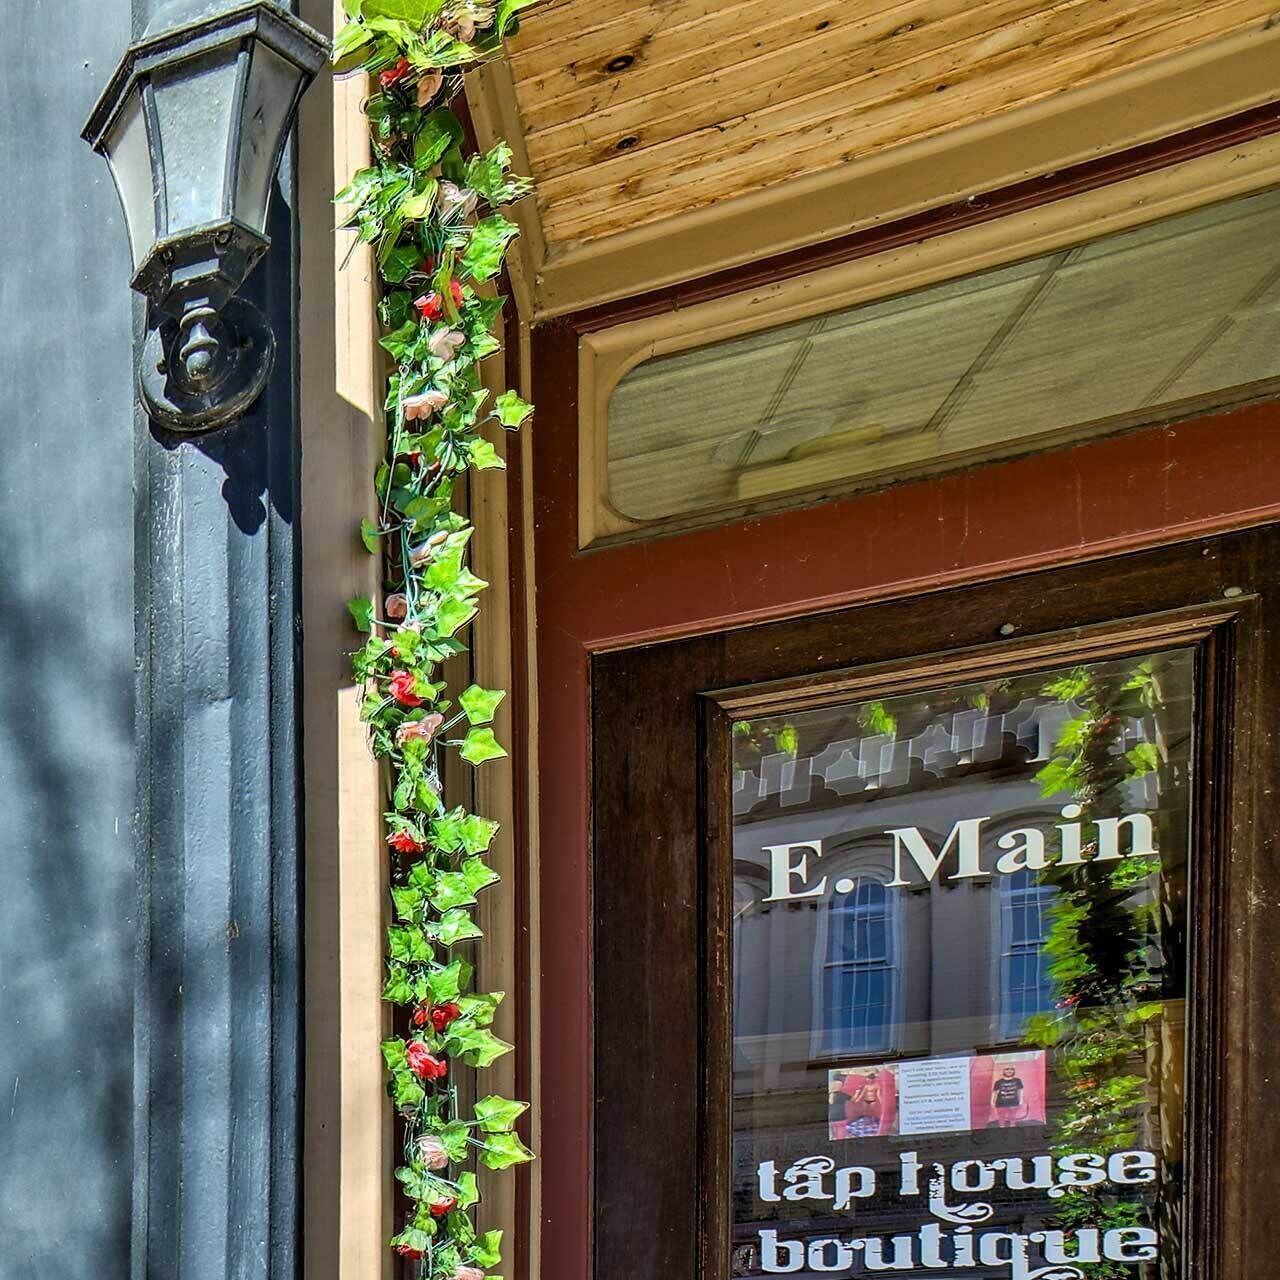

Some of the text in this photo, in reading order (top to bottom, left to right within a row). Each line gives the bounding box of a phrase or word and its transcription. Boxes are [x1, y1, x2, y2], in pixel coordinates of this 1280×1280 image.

[761, 803, 1160, 902] E. Main
[757, 1150, 1158, 1223] tap house
